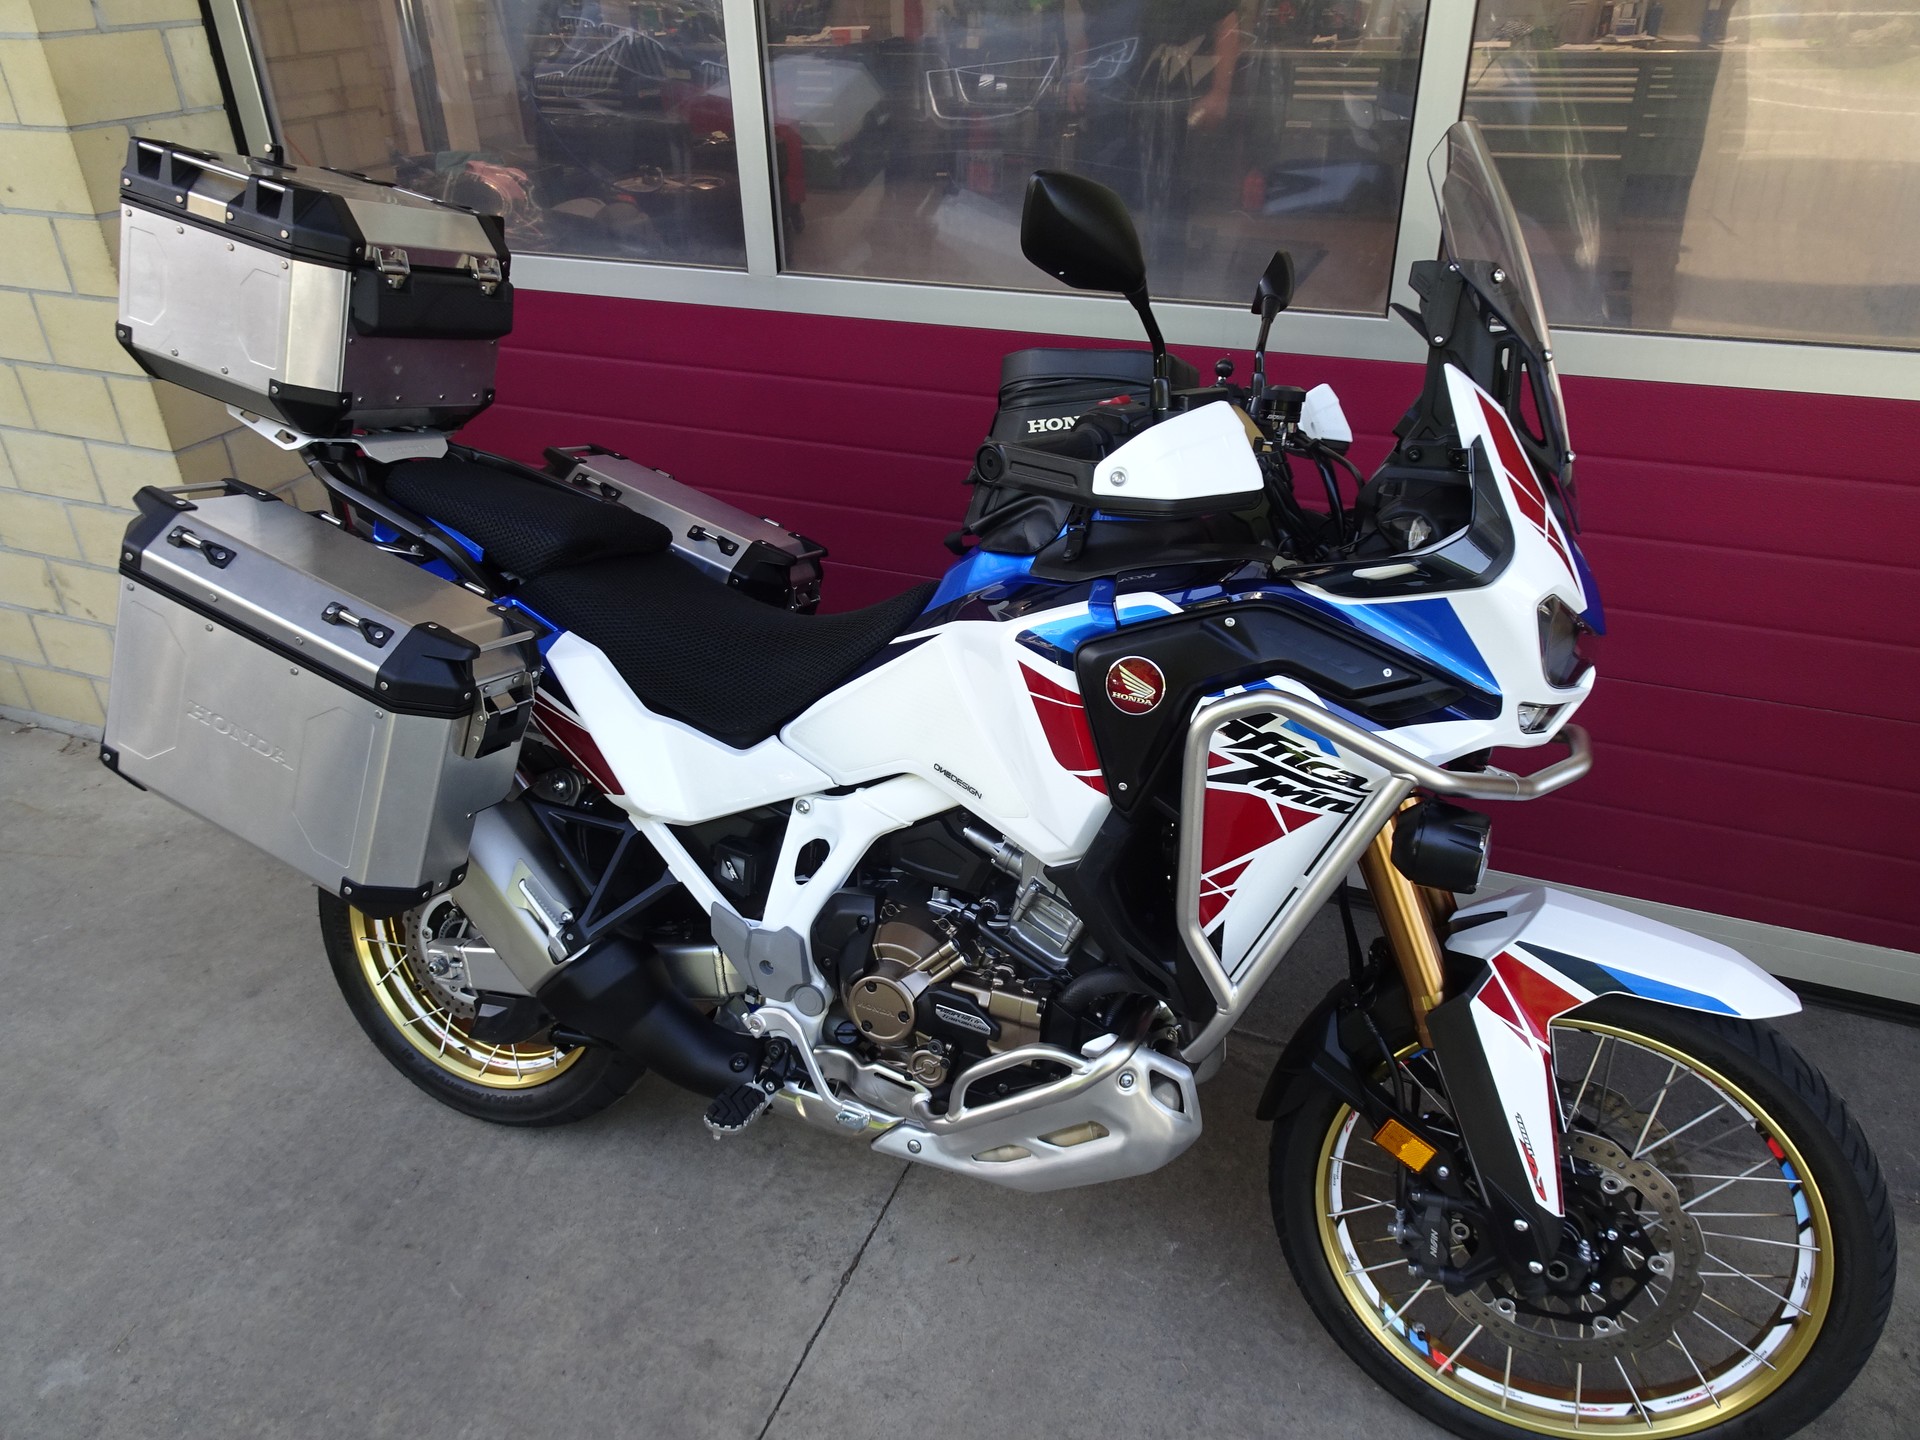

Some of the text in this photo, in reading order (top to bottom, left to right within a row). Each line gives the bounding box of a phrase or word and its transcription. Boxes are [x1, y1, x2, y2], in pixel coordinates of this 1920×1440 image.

[1027, 415, 1081, 434] HON
[1111, 691, 1154, 706] HONDA
[186, 699, 294, 771] HONDA
[933, 762, 983, 800] ONEDESIGN
